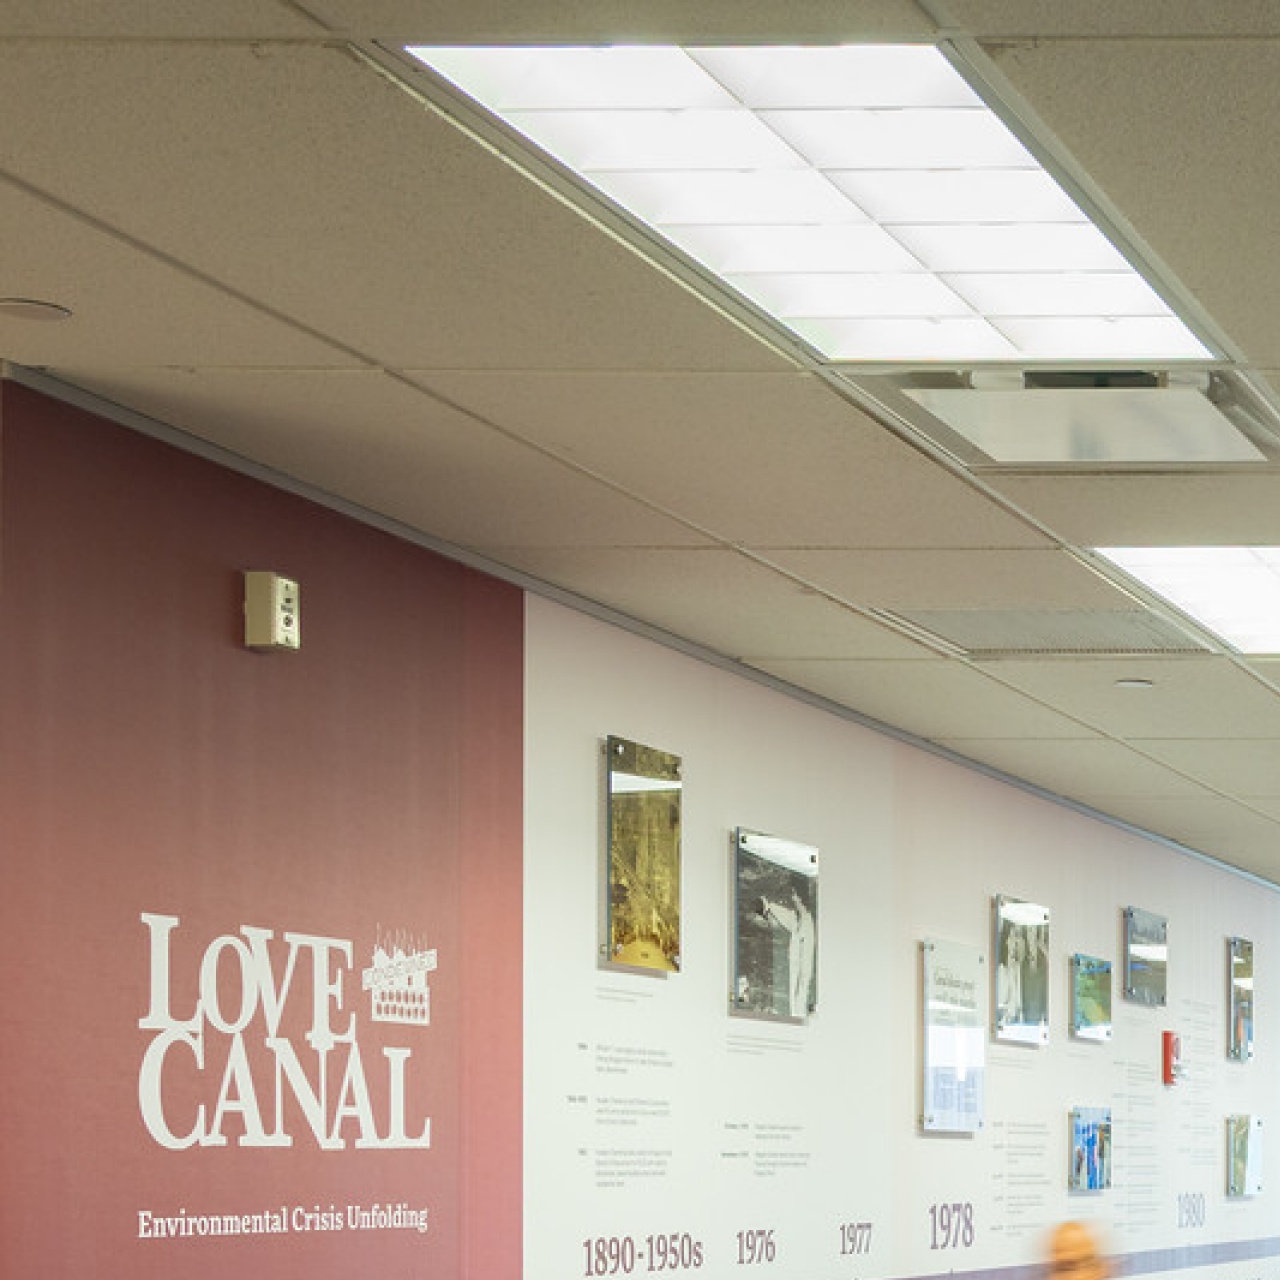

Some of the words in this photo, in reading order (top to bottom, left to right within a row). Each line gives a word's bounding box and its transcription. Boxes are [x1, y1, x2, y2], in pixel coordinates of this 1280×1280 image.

[138, 912, 356, 1051] LOVE
[138, 1026, 430, 1149] CANAL
[137, 1206, 288, 1238] Environmental
[292, 1205, 344, 1231] Crisis
[347, 1203, 428, 1232] Unfolding
[839, 1222, 872, 1255] 1977
[928, 1203, 975, 1250] 1978
[735, 1229, 776, 1265] 1976
